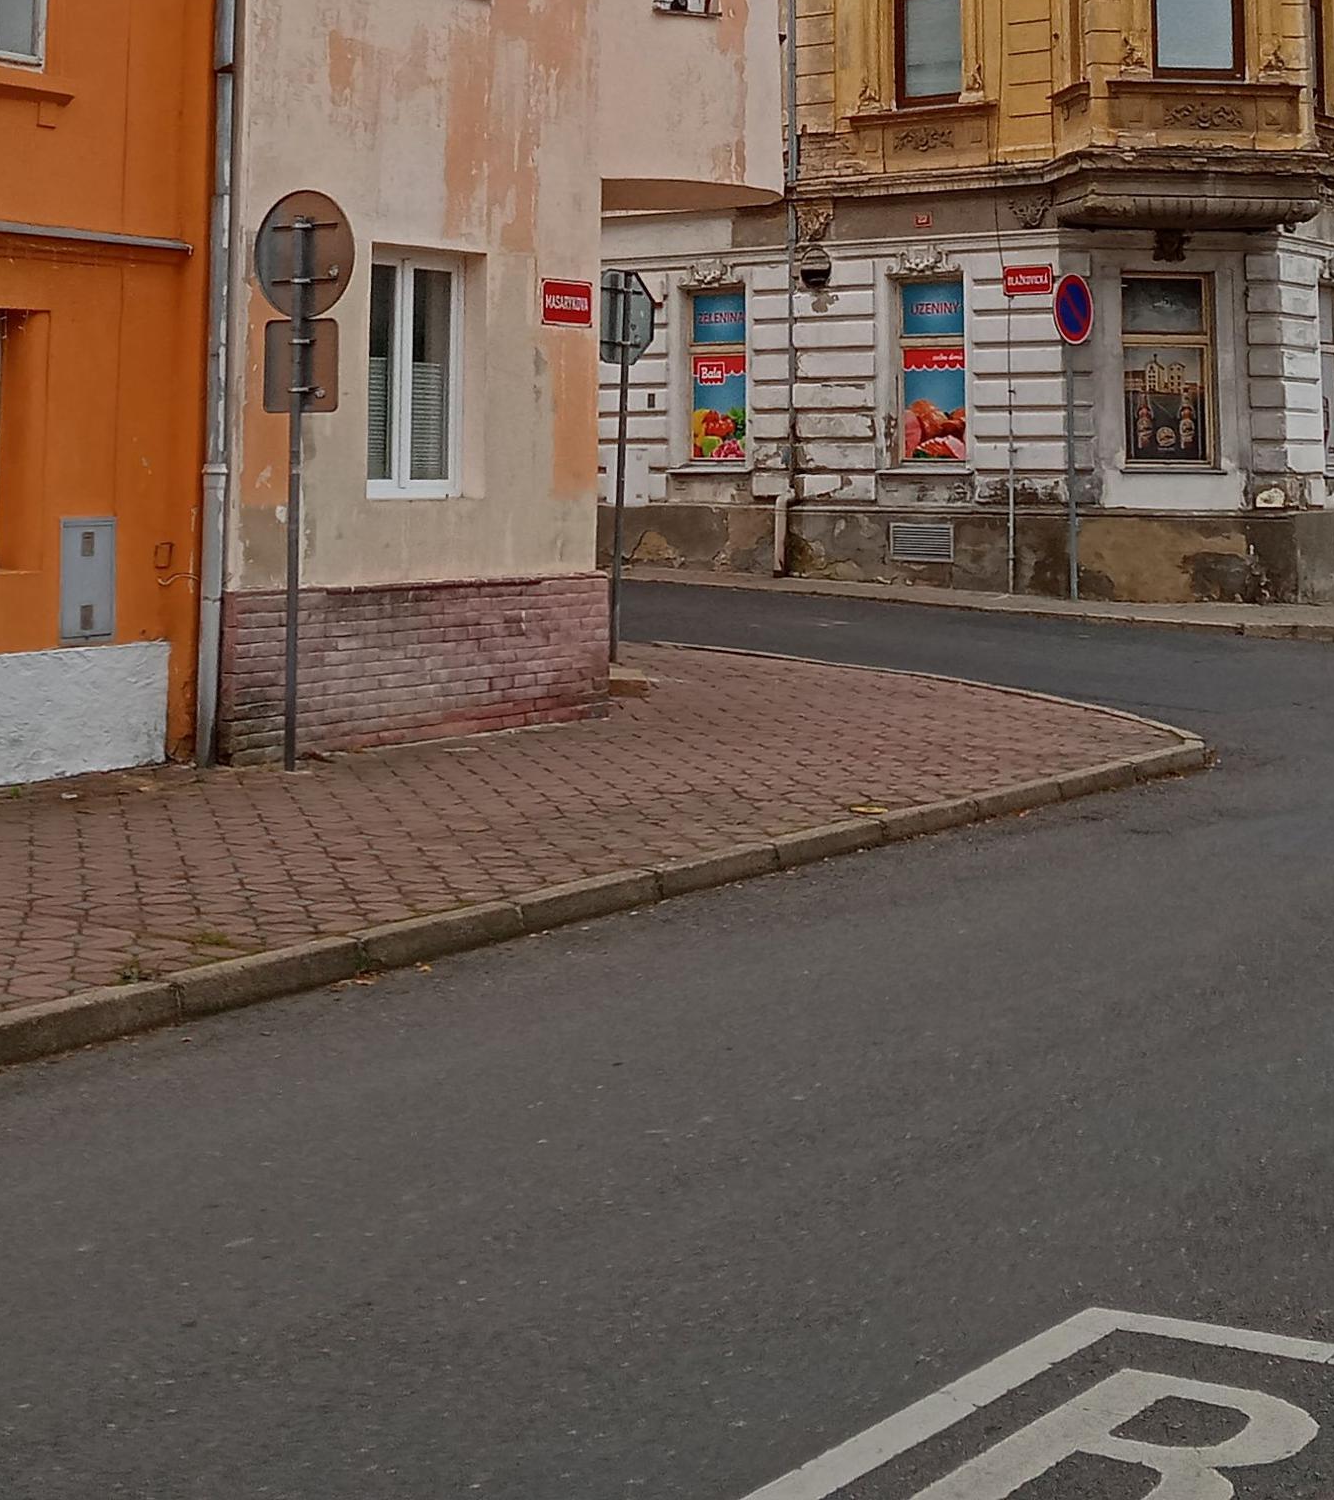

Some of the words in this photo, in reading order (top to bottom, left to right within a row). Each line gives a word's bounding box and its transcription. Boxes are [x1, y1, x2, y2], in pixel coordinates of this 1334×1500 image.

[545, 294, 588, 311] MASARYKOVA
[911, 301, 959, 315] UZENINY
[698, 311, 746, 325] ZELENINA
